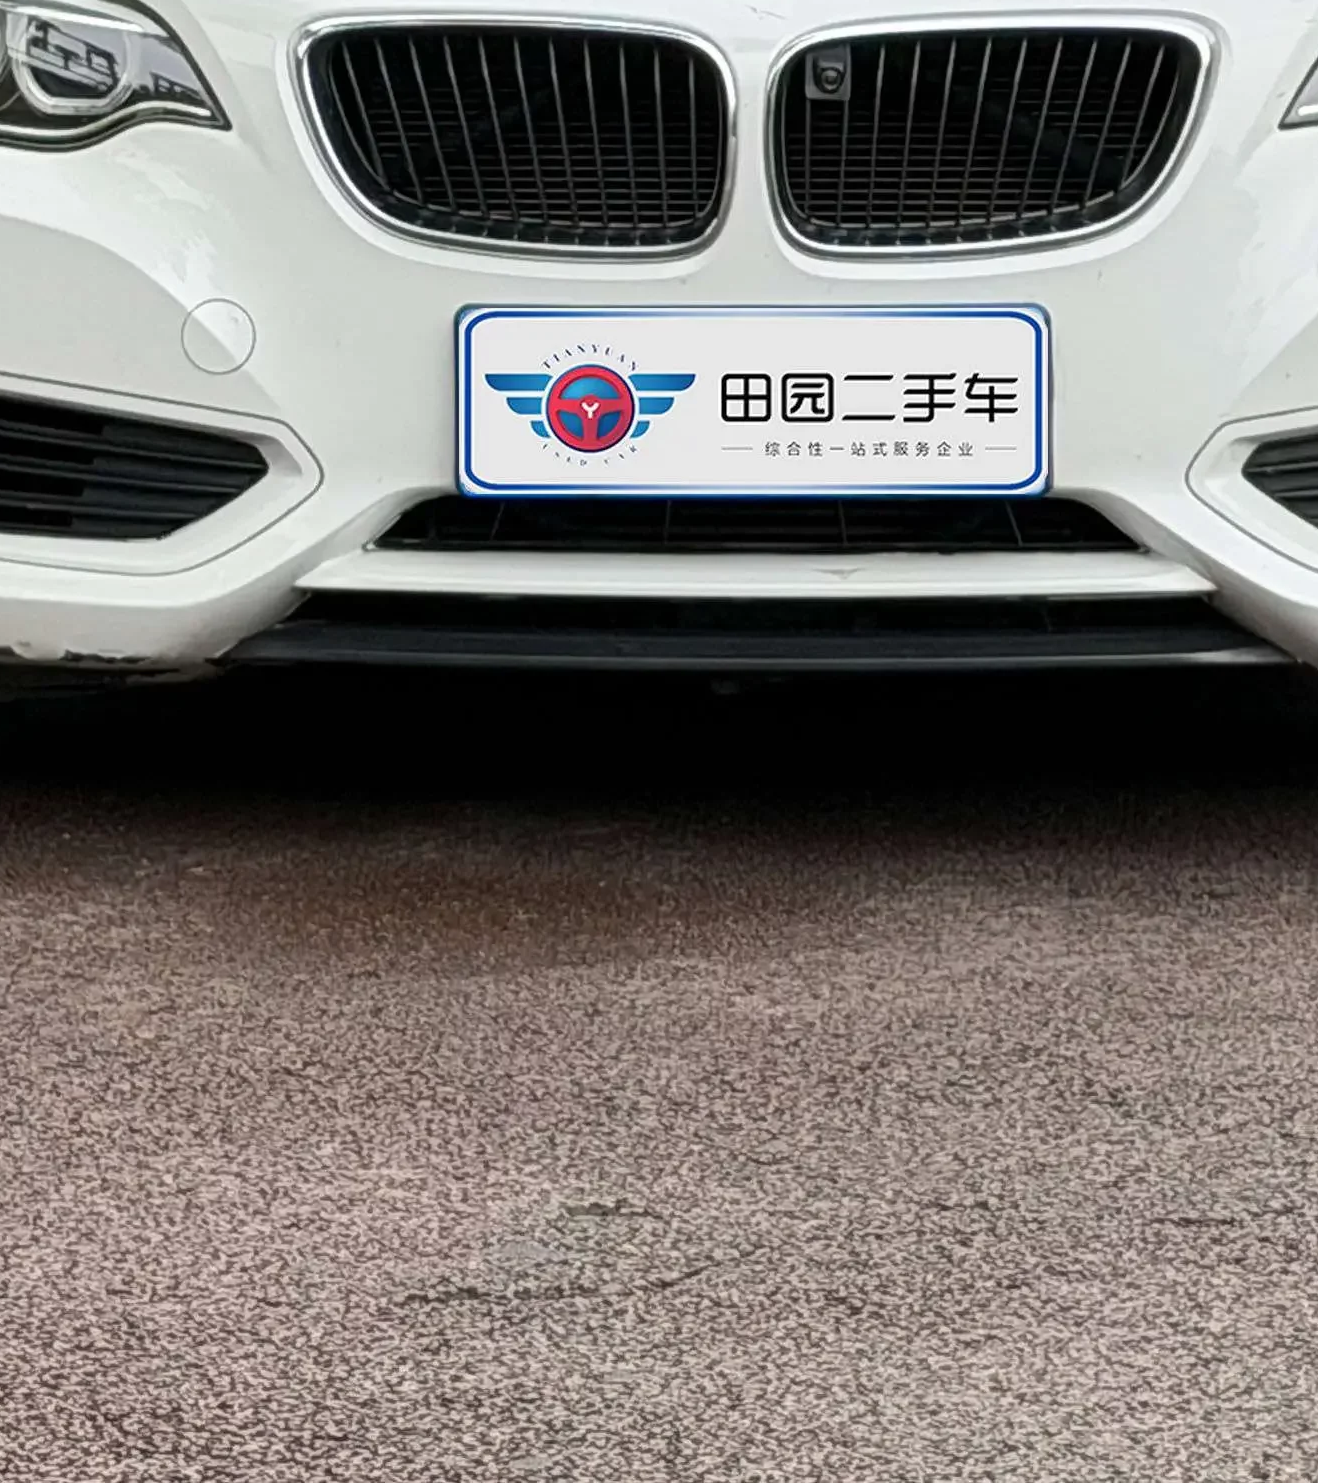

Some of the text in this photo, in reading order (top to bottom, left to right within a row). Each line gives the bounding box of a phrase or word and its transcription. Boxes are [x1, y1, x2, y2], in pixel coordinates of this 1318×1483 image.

[721, 373, 1018, 422] 田园二手车
[764, 441, 974, 457] 综合性一站式服务企业
